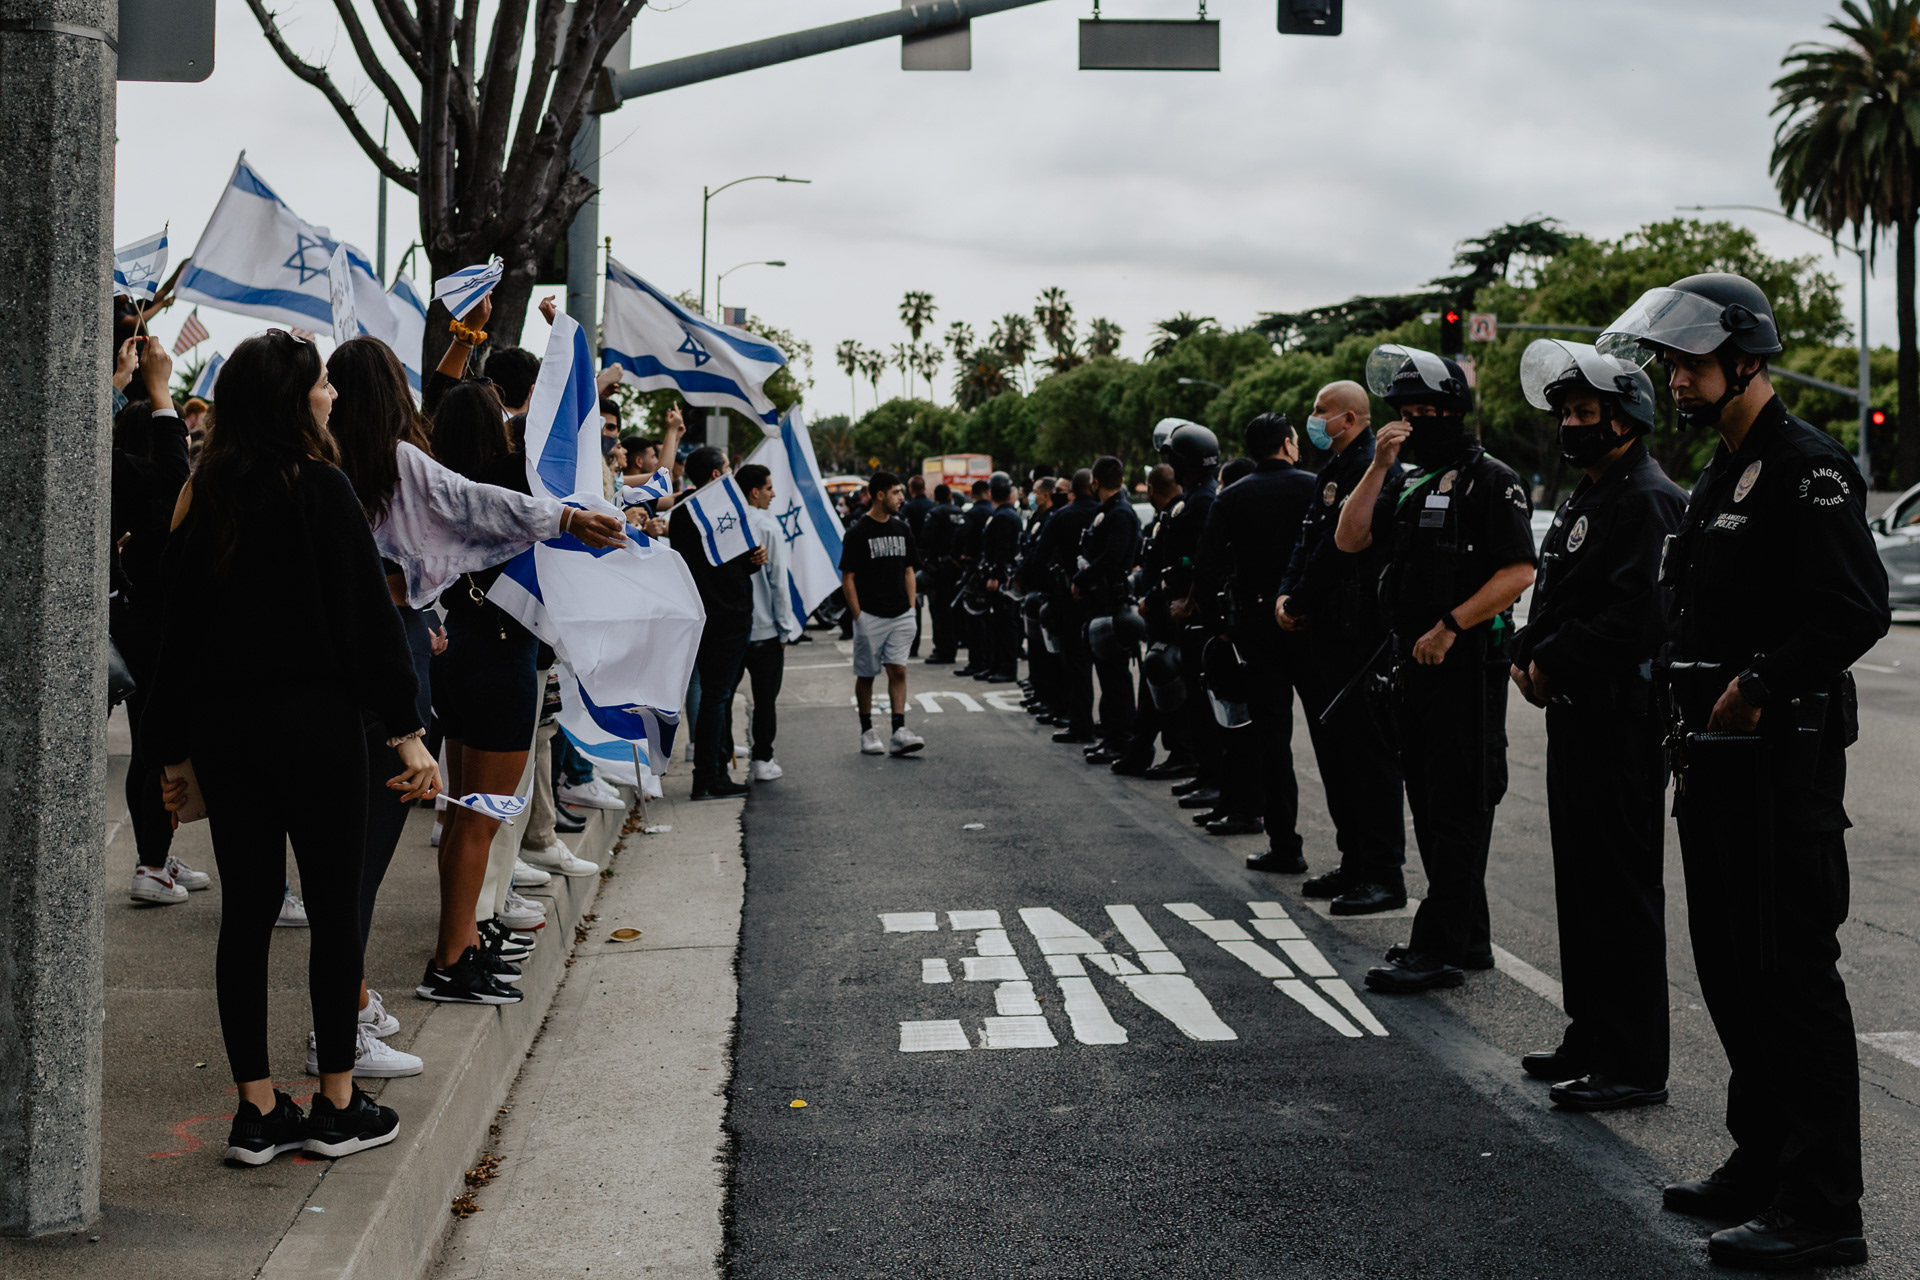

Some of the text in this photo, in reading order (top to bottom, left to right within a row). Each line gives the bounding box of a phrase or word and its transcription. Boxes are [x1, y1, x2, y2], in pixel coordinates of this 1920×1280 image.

[1799, 468, 1850, 498] LOS ANGELES
[1813, 495, 1845, 506] POLICE
[1713, 519, 1740, 530] POLICE
